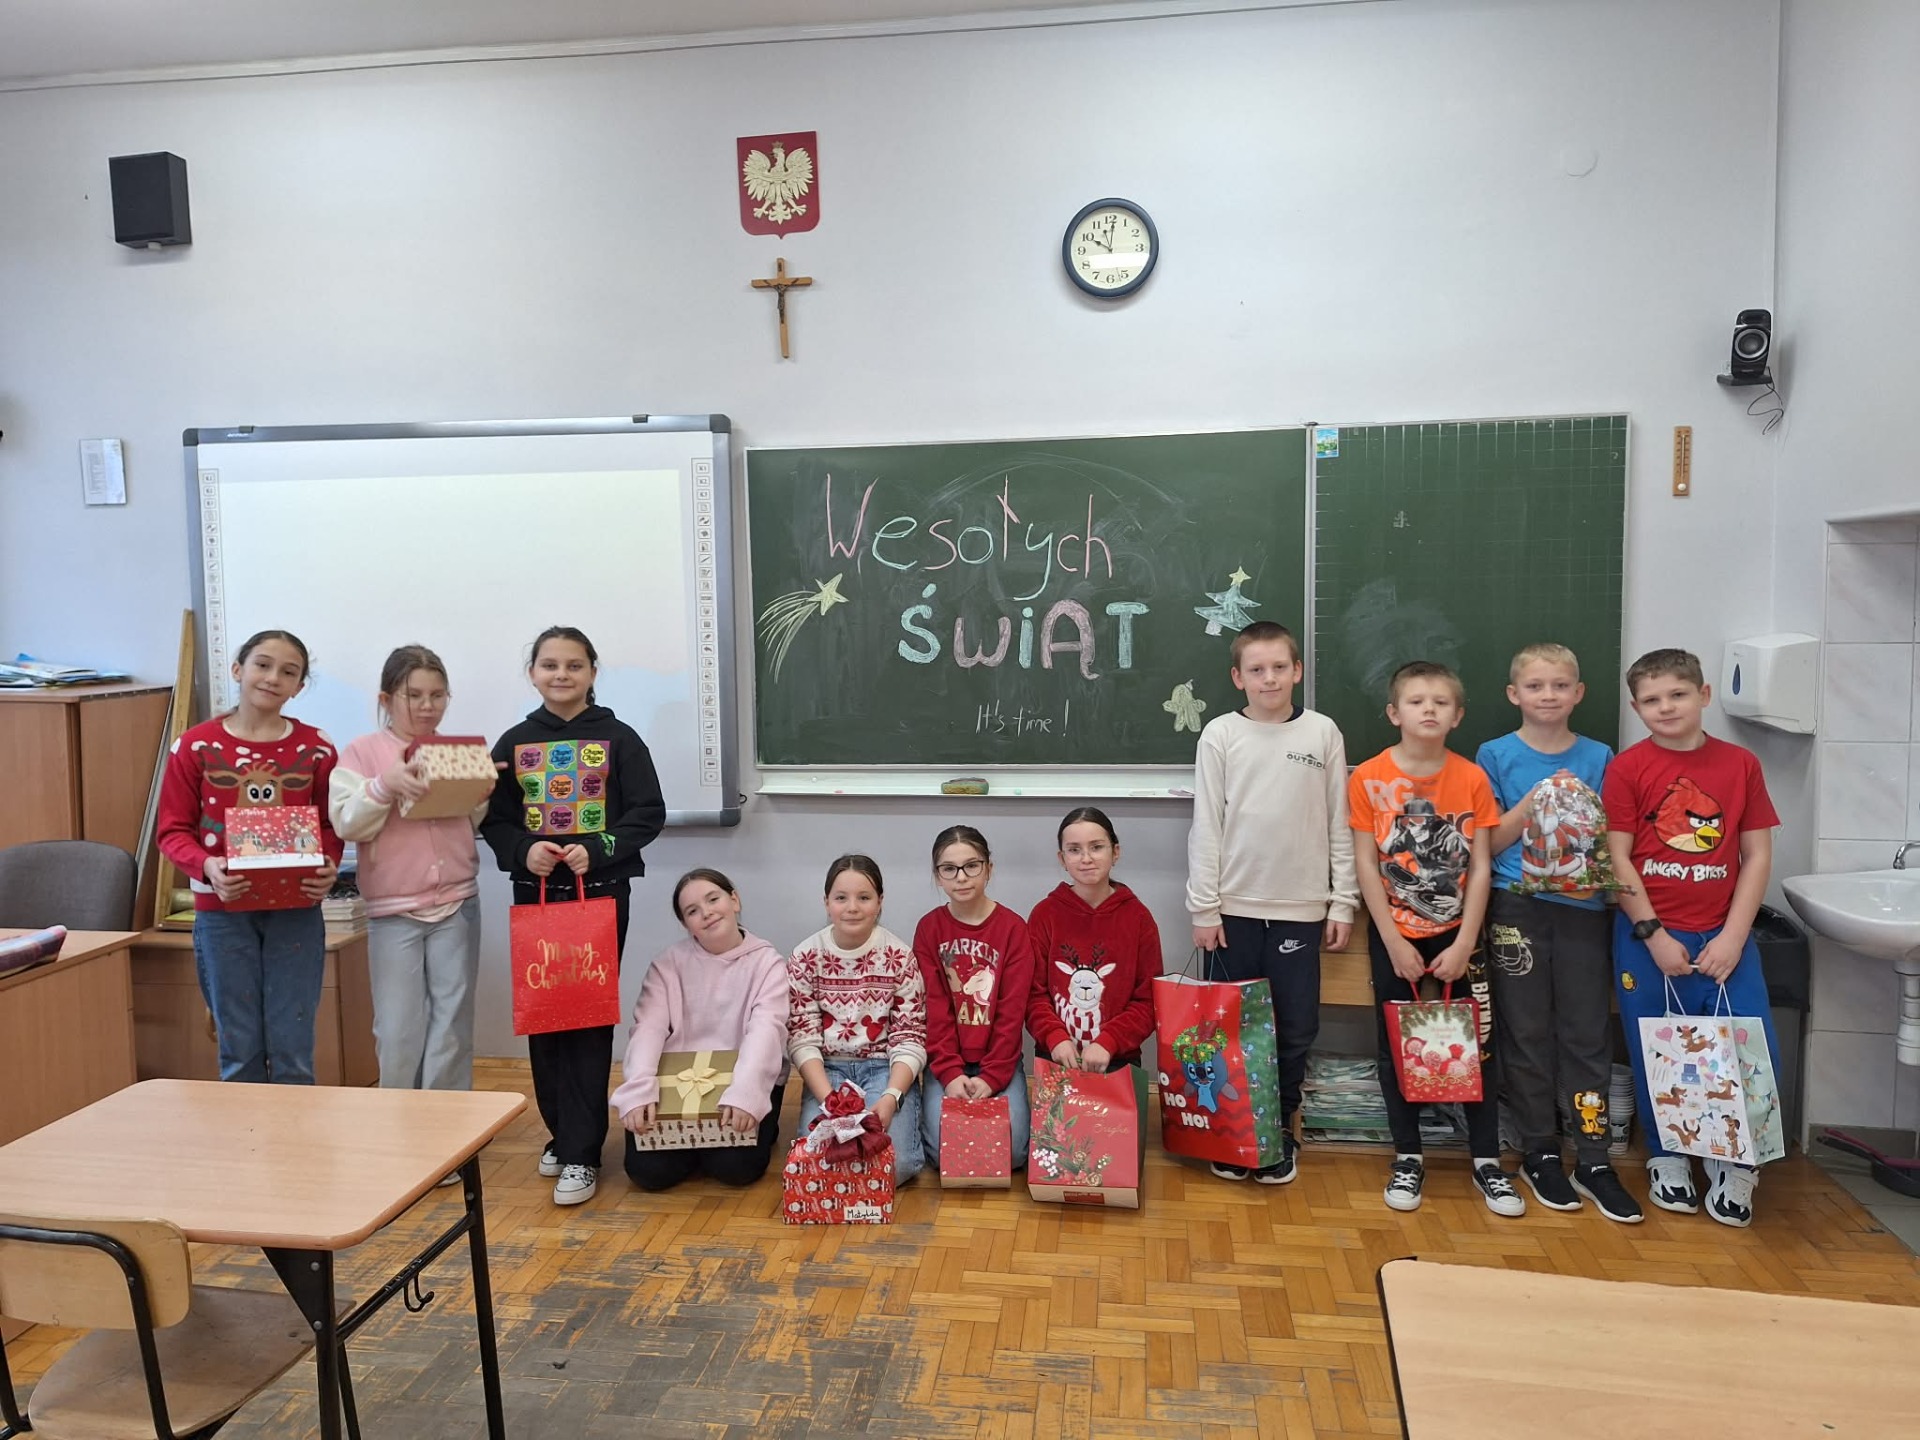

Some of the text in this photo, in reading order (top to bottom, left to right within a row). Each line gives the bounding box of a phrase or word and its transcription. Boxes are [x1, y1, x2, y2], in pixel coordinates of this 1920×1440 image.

[1104, 214, 1117, 224] 12
[1123, 218, 1127, 227] 1
[1092, 220, 1101, 229] 11
[1082, 232, 1094, 241] 10
[1131, 228, 1140, 237] 2
[1077, 246, 1086, 255] 9
[1135, 243, 1144, 252] 3
[1082, 260, 1091, 269] 8
[1092, 271, 1100, 280] 7
[1106, 274, 1115, 283] 6
[1120, 269, 1129, 279] 5
[826, 473, 1112, 601] Wesołych
[976, 699, 1005, 734] It's
[1642, 858, 1690, 881] ANGRY
[938, 937, 1000, 969] PARKLE
[1163, 1092, 1187, 1108] HO
[1181, 1111, 1210, 1130] HO!
